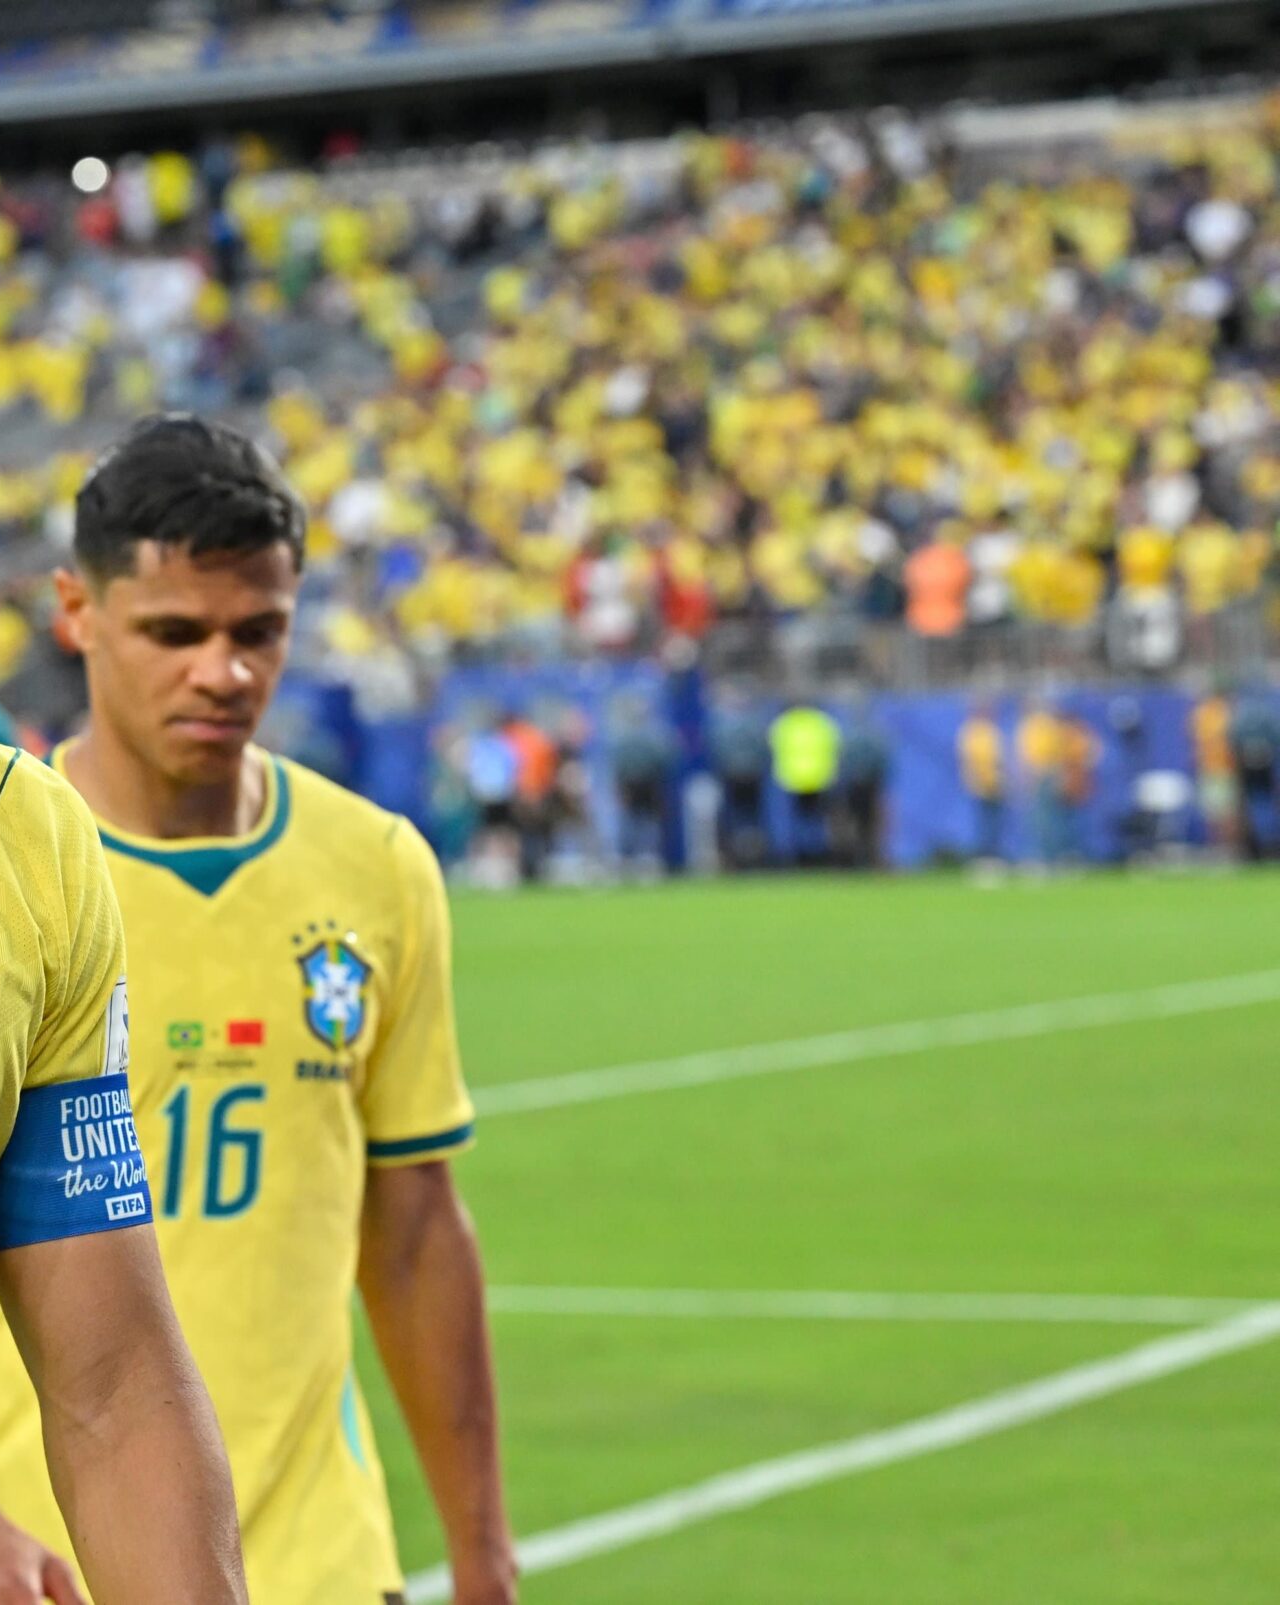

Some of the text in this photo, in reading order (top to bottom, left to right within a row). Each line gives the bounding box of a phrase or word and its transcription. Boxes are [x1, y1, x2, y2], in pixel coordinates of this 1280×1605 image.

[60, 1088, 132, 1125] FOOTBAL
[162, 1083, 266, 1220] 16
[57, 1164, 109, 1198] the
[111, 1197, 144, 1216] FIFA
